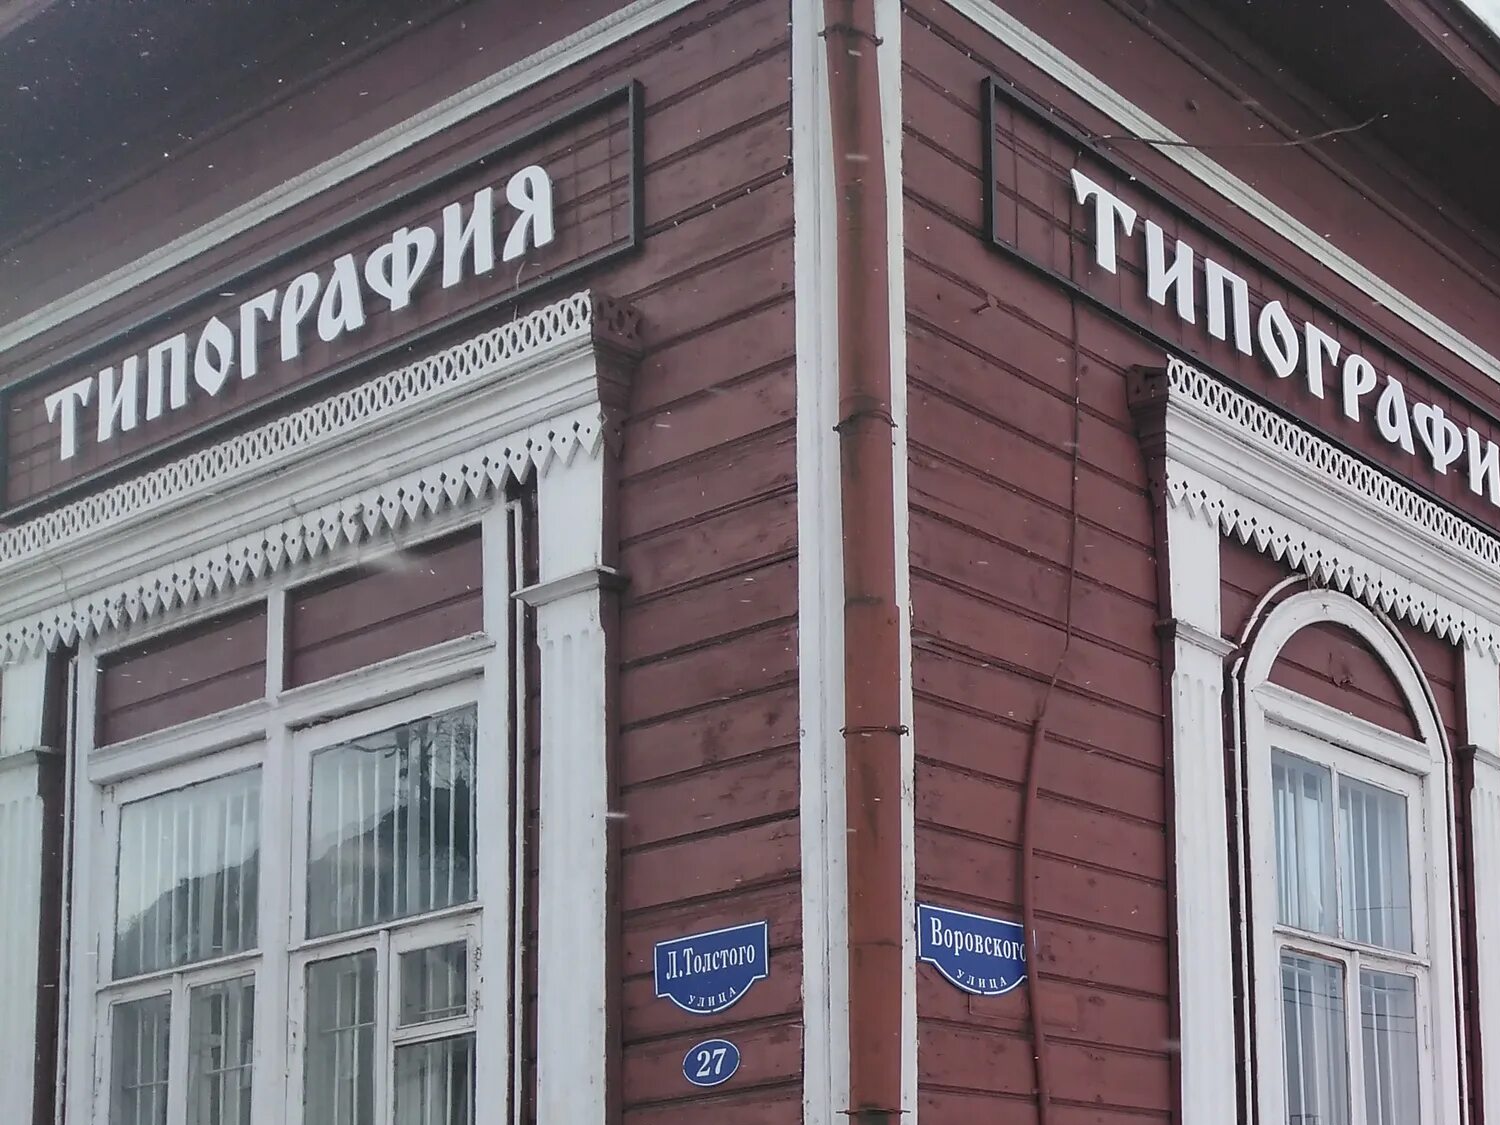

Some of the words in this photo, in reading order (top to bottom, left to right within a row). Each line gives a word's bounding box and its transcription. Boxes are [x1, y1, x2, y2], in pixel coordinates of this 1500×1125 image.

[44, 164, 556, 461] ТИПОГРАФИЯ
[930, 916, 1026, 962] Воровского
[696, 1048, 727, 1078] 27
